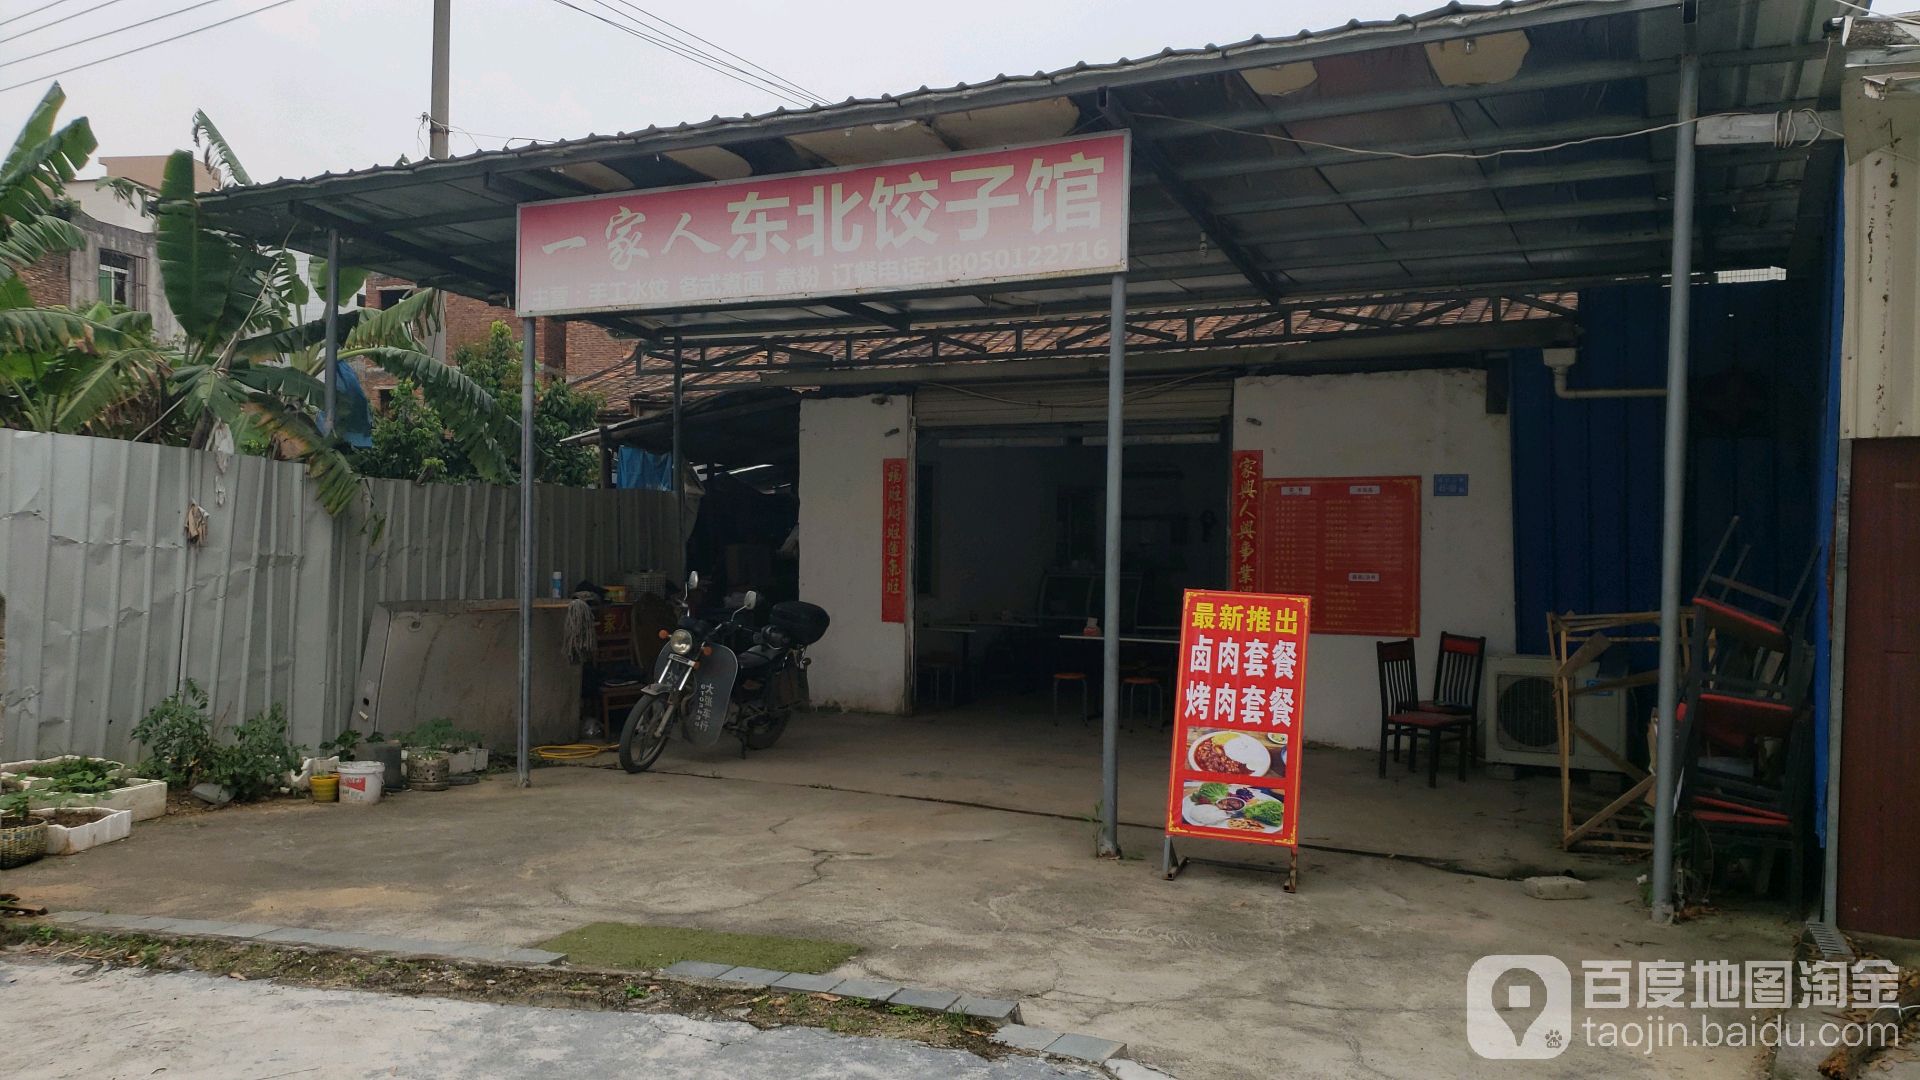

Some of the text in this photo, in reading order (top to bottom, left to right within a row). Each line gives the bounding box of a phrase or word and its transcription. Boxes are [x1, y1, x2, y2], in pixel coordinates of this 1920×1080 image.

[542, 152, 1105, 271] 一家人东北饺子馆
[1191, 602, 1298, 635] 最新推出
[1190, 634, 1297, 680] 卤肉套餐
[1184, 680, 1295, 728] 烤肉套餐
